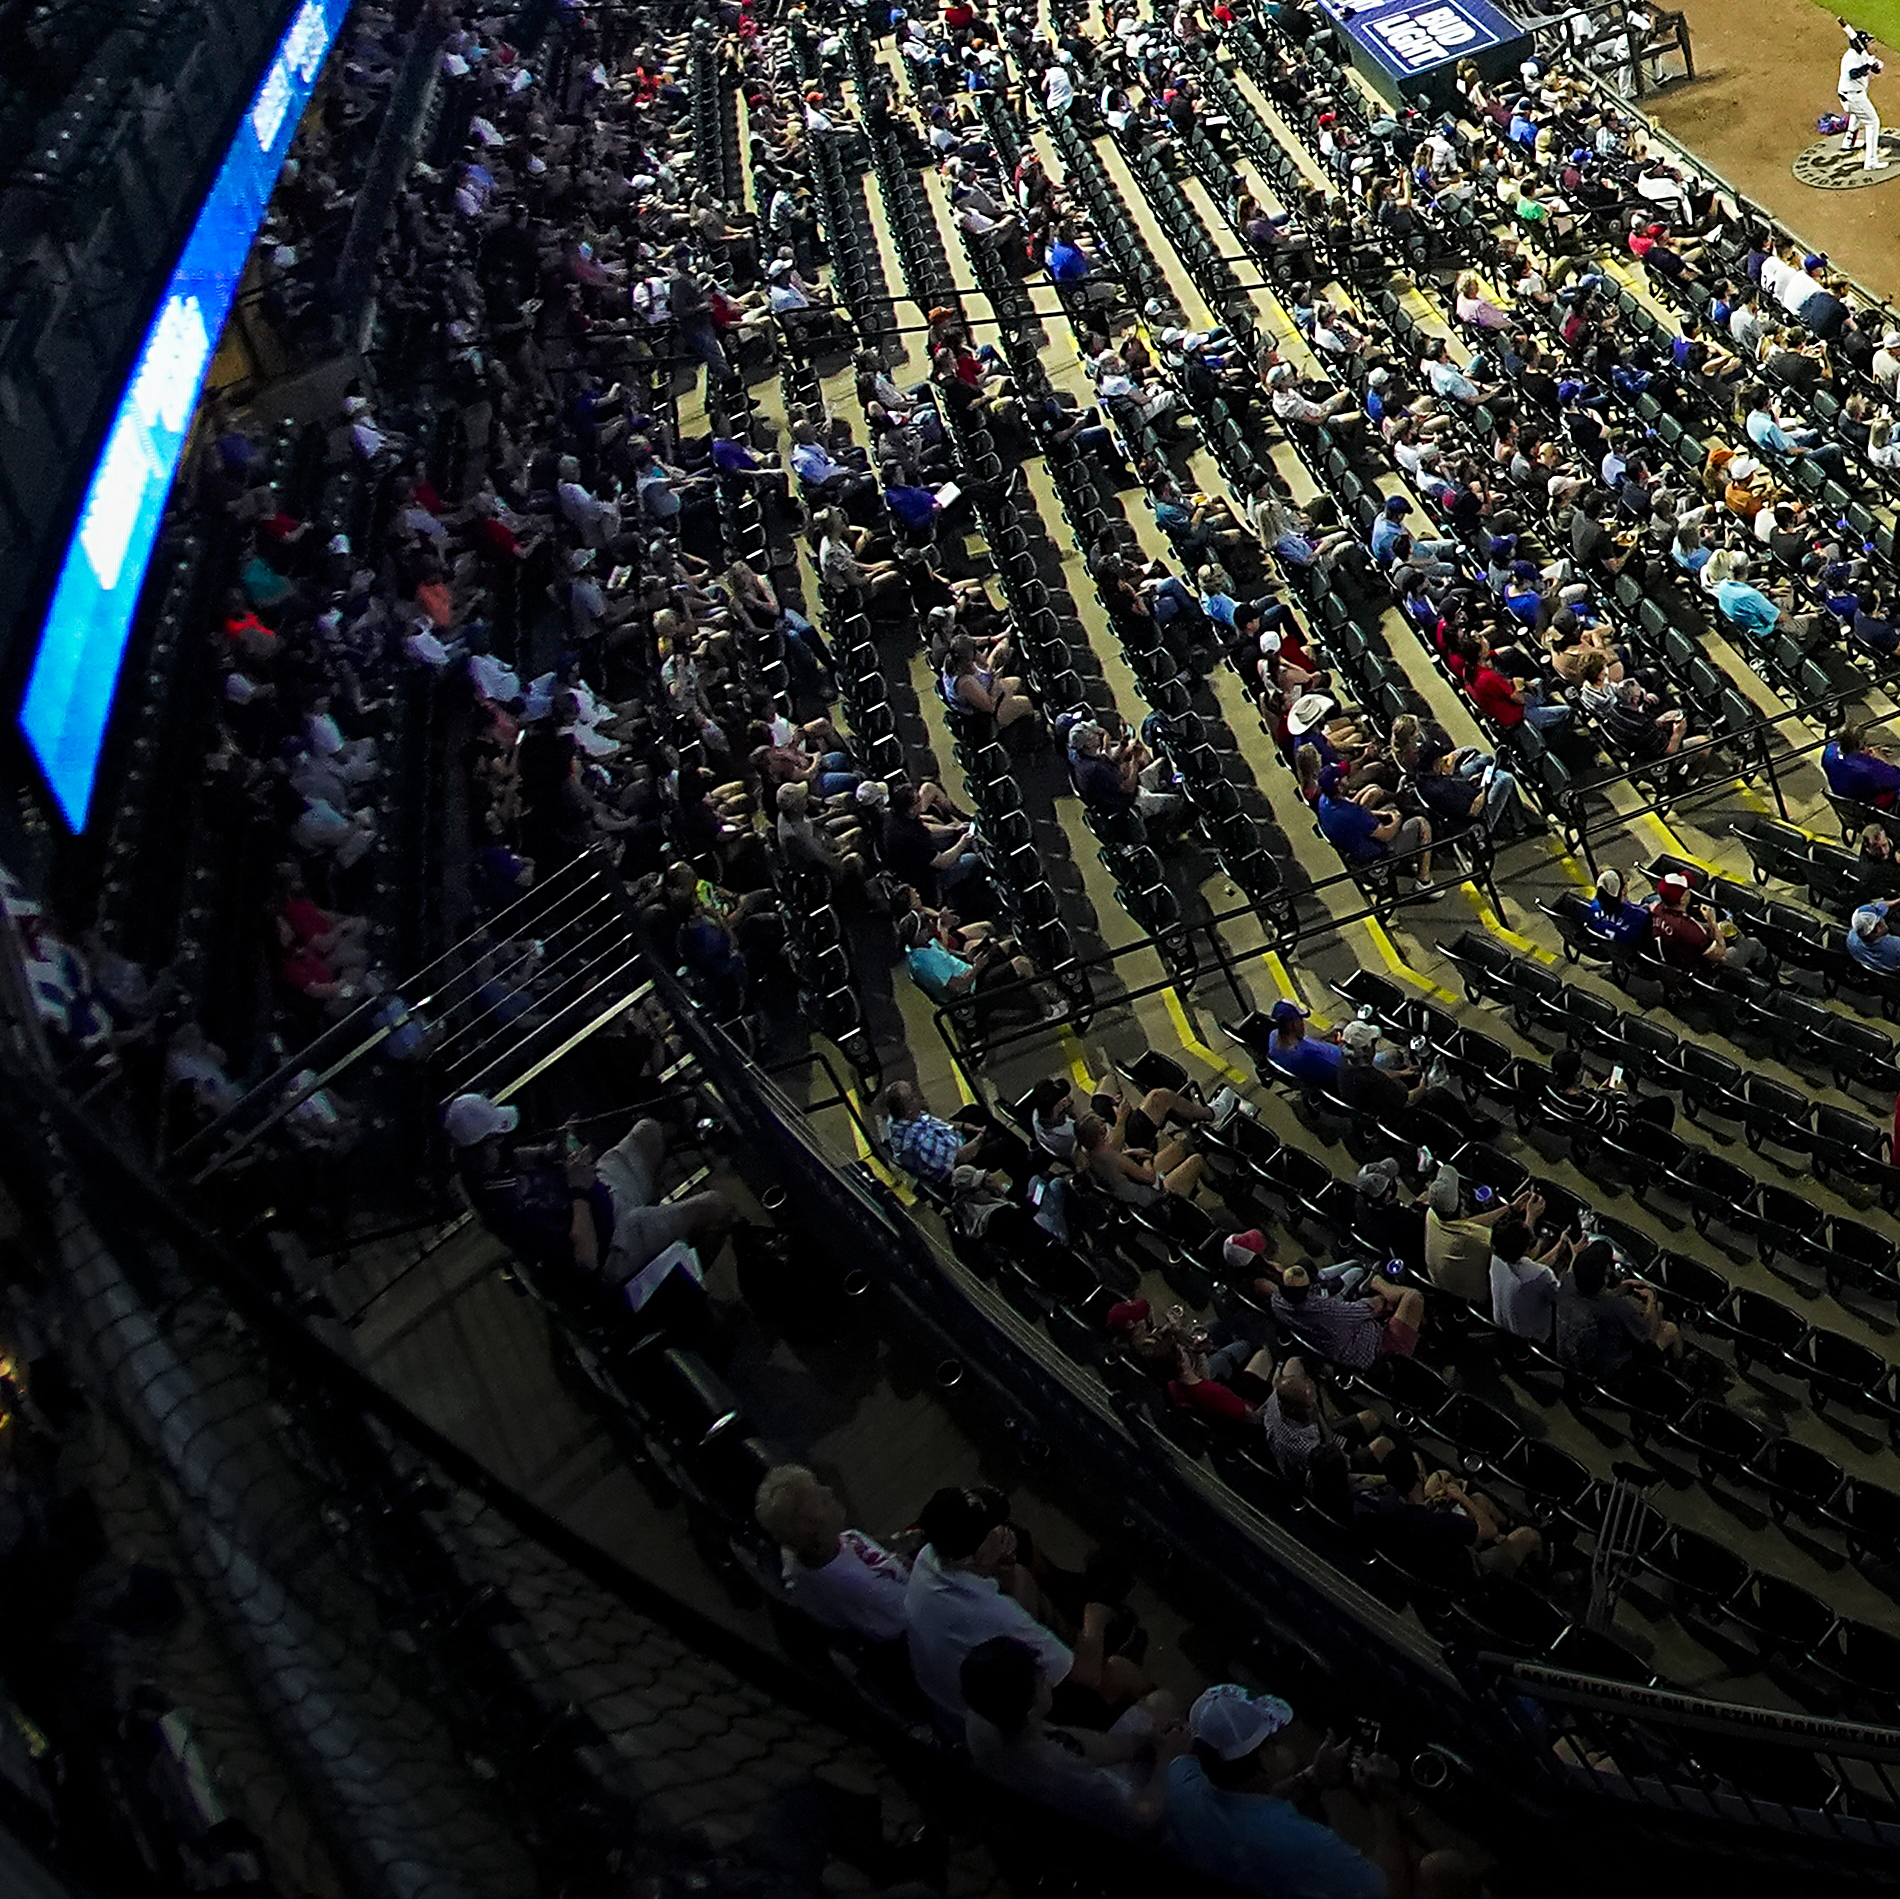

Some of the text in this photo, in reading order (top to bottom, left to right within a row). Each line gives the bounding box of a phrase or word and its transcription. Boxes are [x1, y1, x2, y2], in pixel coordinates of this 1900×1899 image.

[1372, 12, 1450, 68] LIGHT
[1414, 6, 1477, 47] BUD
[1547, 1672, 1580, 1692] NOT
[1721, 1706, 1778, 1731] STAND
[1782, 1717, 1860, 1745] AGAINST
